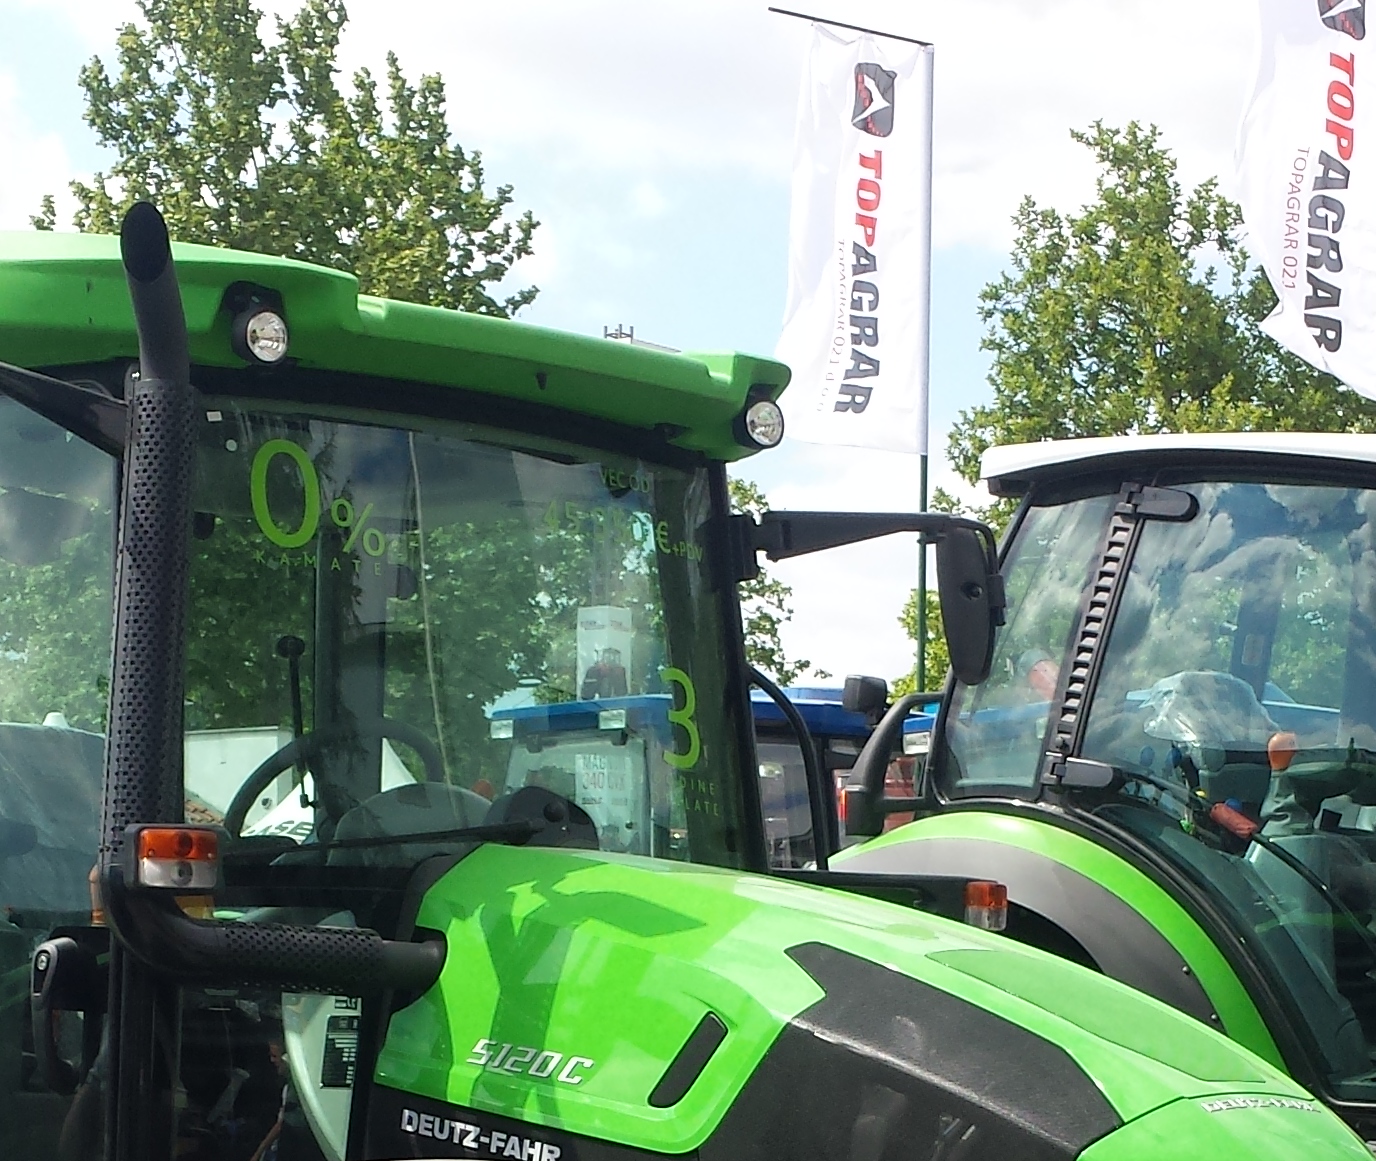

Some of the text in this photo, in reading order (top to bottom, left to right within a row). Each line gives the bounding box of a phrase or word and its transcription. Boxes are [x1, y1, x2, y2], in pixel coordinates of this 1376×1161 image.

[1283, 145, 1311, 250] TOPAGRAR
[1303, 51, 1355, 354] TOPAGRAR
[832, 149, 883, 414] TOPAGRAR
[254, 550, 382, 576] KAMATE
[660, 667, 702, 770] 3
